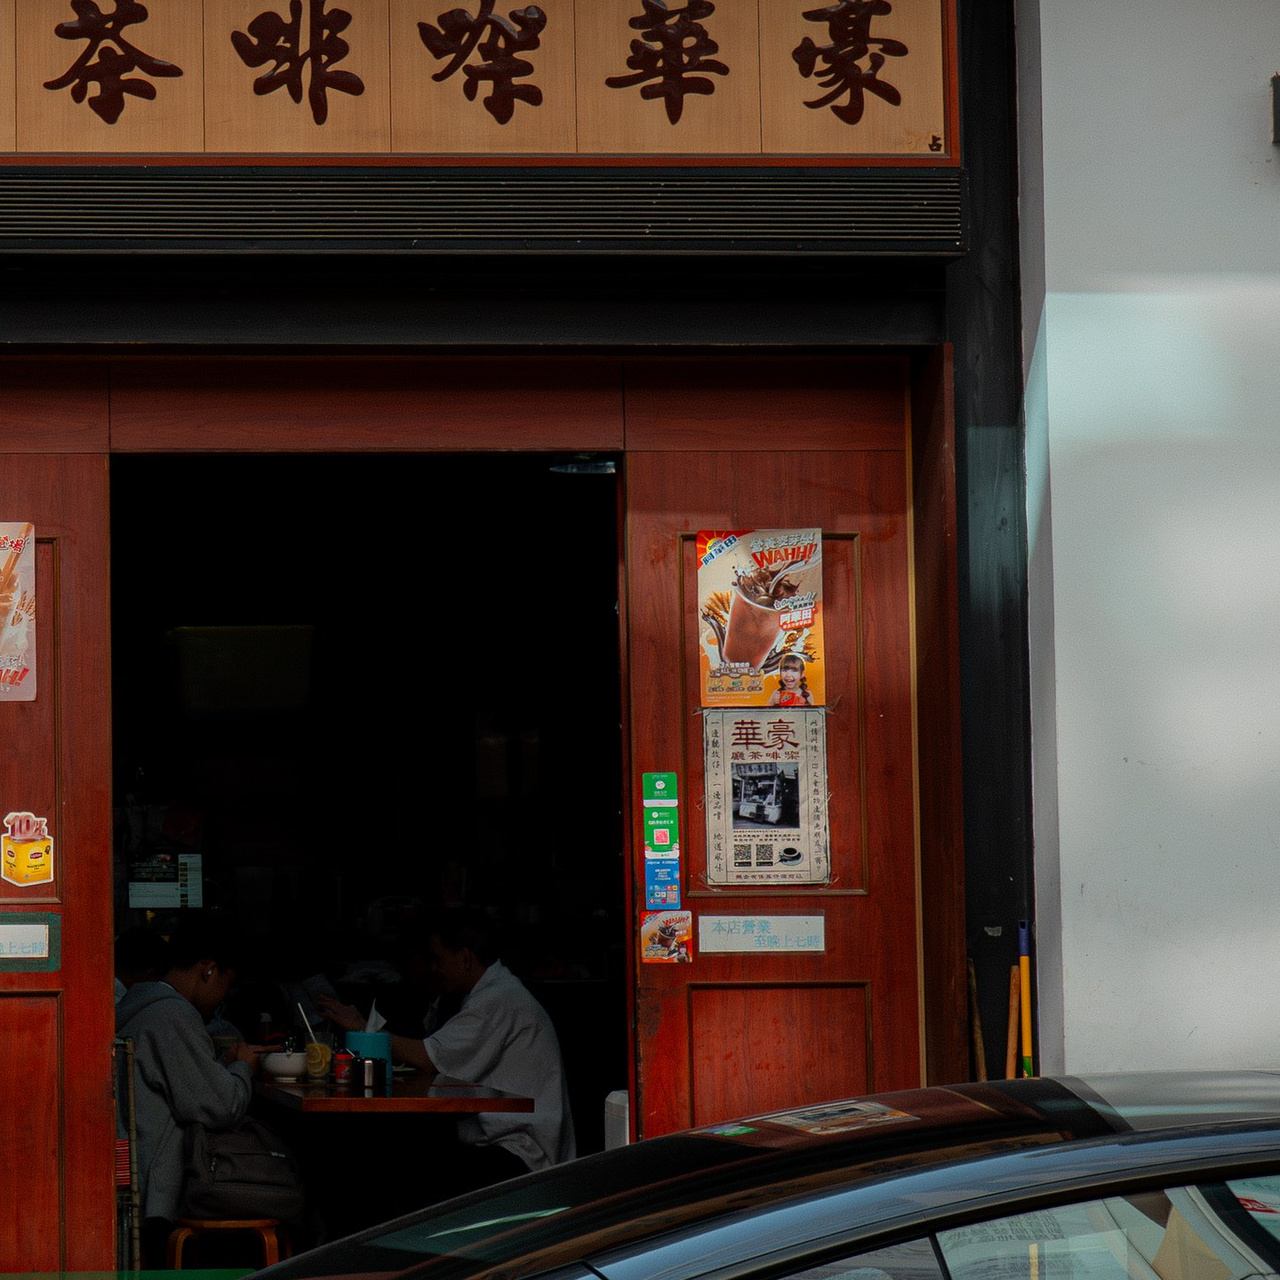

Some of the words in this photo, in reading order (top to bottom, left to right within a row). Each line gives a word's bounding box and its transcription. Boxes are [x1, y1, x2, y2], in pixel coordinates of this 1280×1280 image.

[751, 543, 818, 568] WAHH!
[730, 718, 800, 751] 豪華
[6, 814, 47, 837] 10%
[712, 919, 772, 934] 本店營業
[754, 935, 821, 949] 至晚上七時
